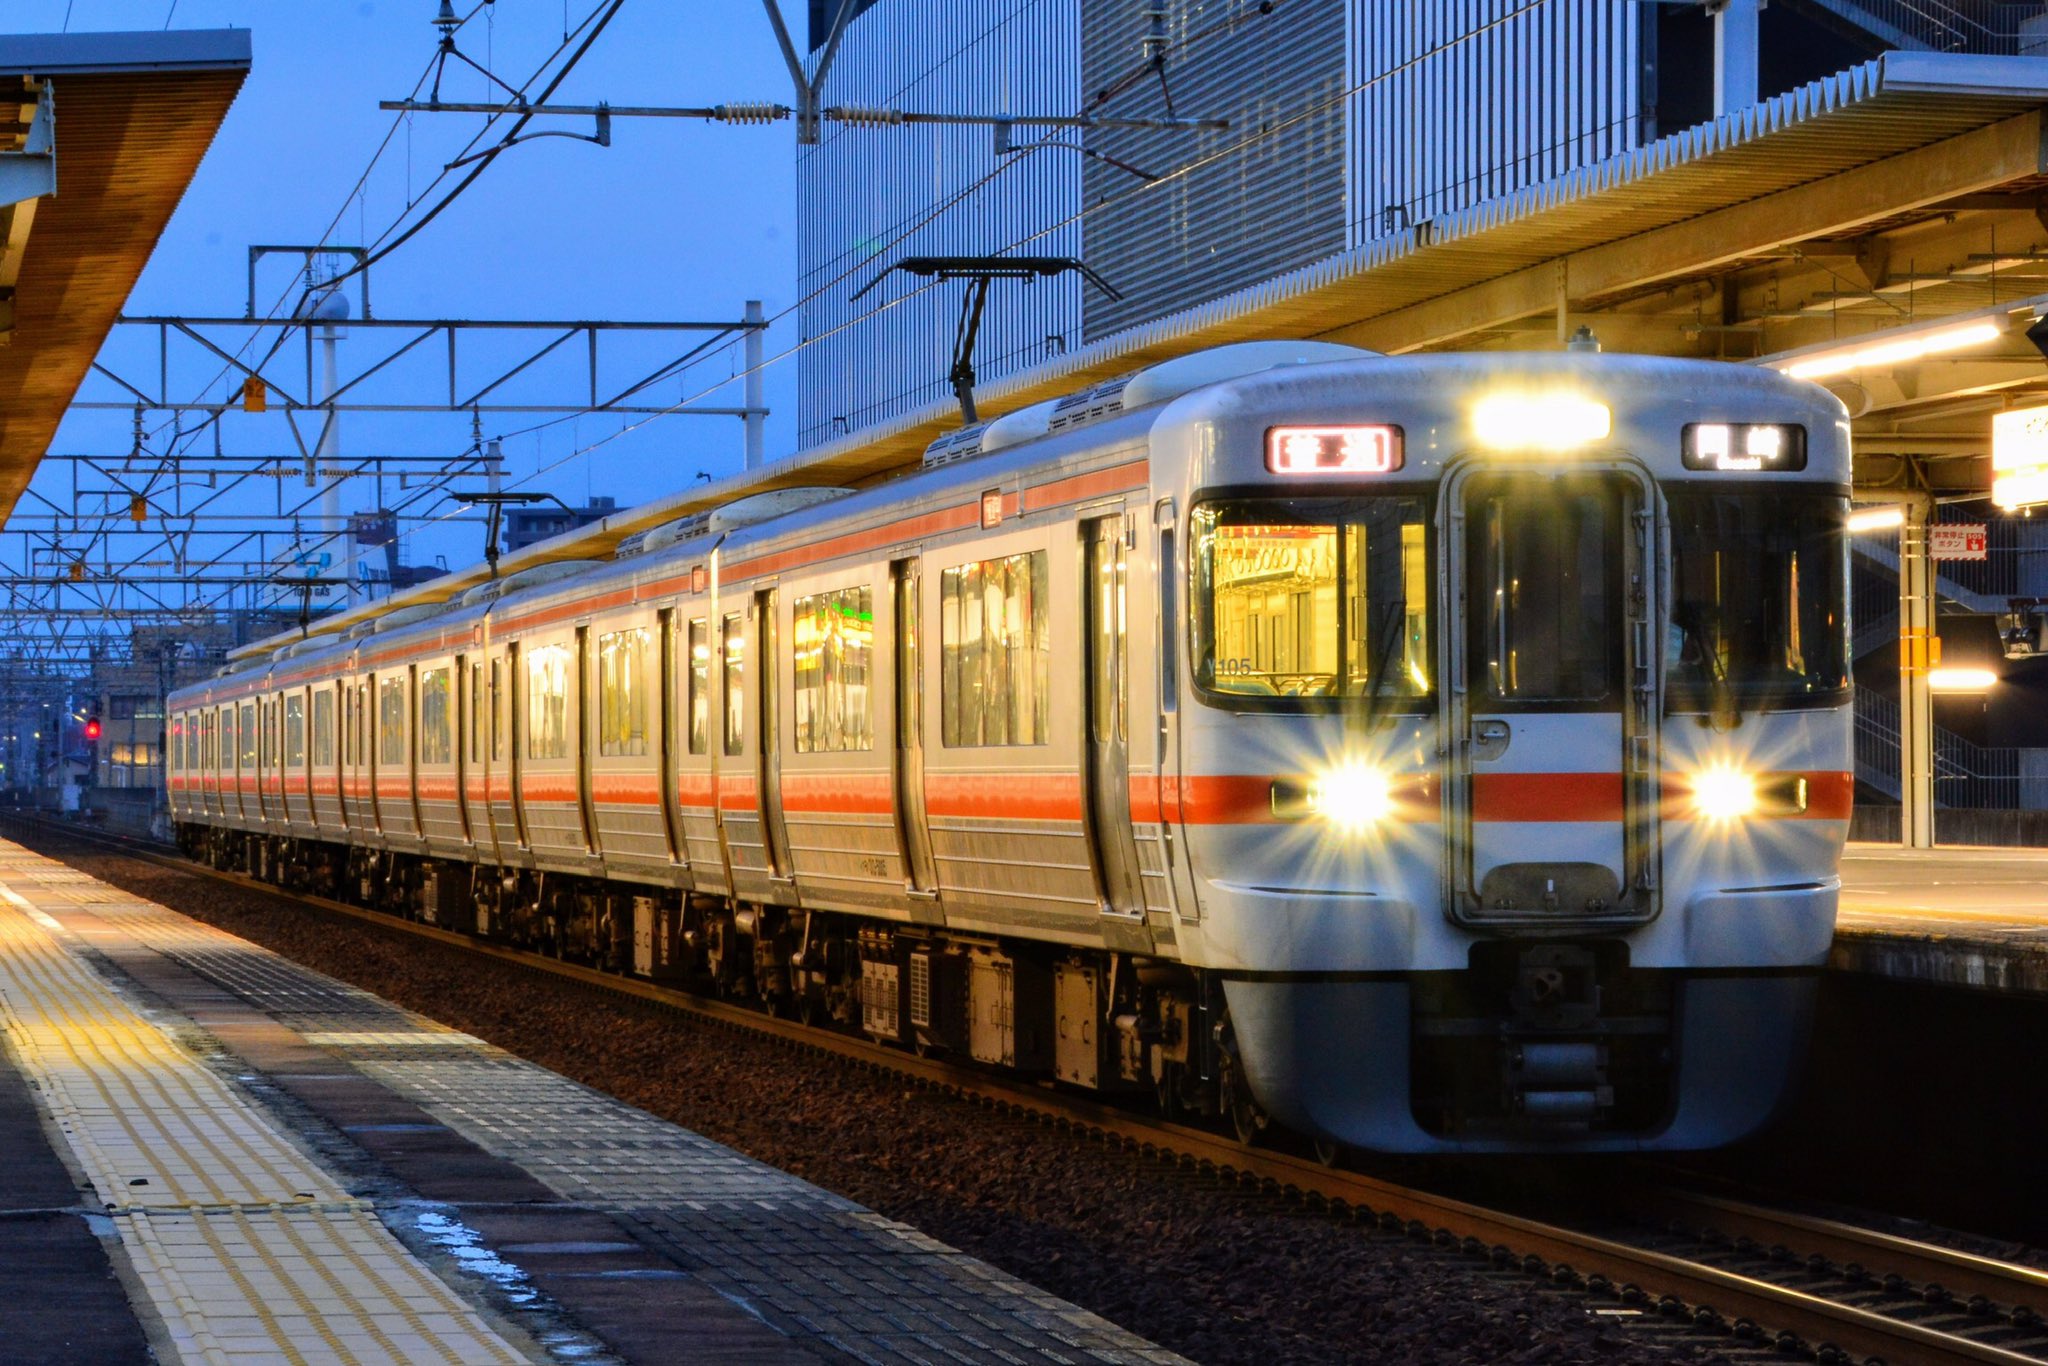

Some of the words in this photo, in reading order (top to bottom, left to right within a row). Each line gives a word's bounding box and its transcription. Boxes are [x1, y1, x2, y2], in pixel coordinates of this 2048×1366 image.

[1934, 531, 1964, 539] 非常停止
[315, 587, 330, 597] GAS
[1208, 658, 1251, 677] Y105
